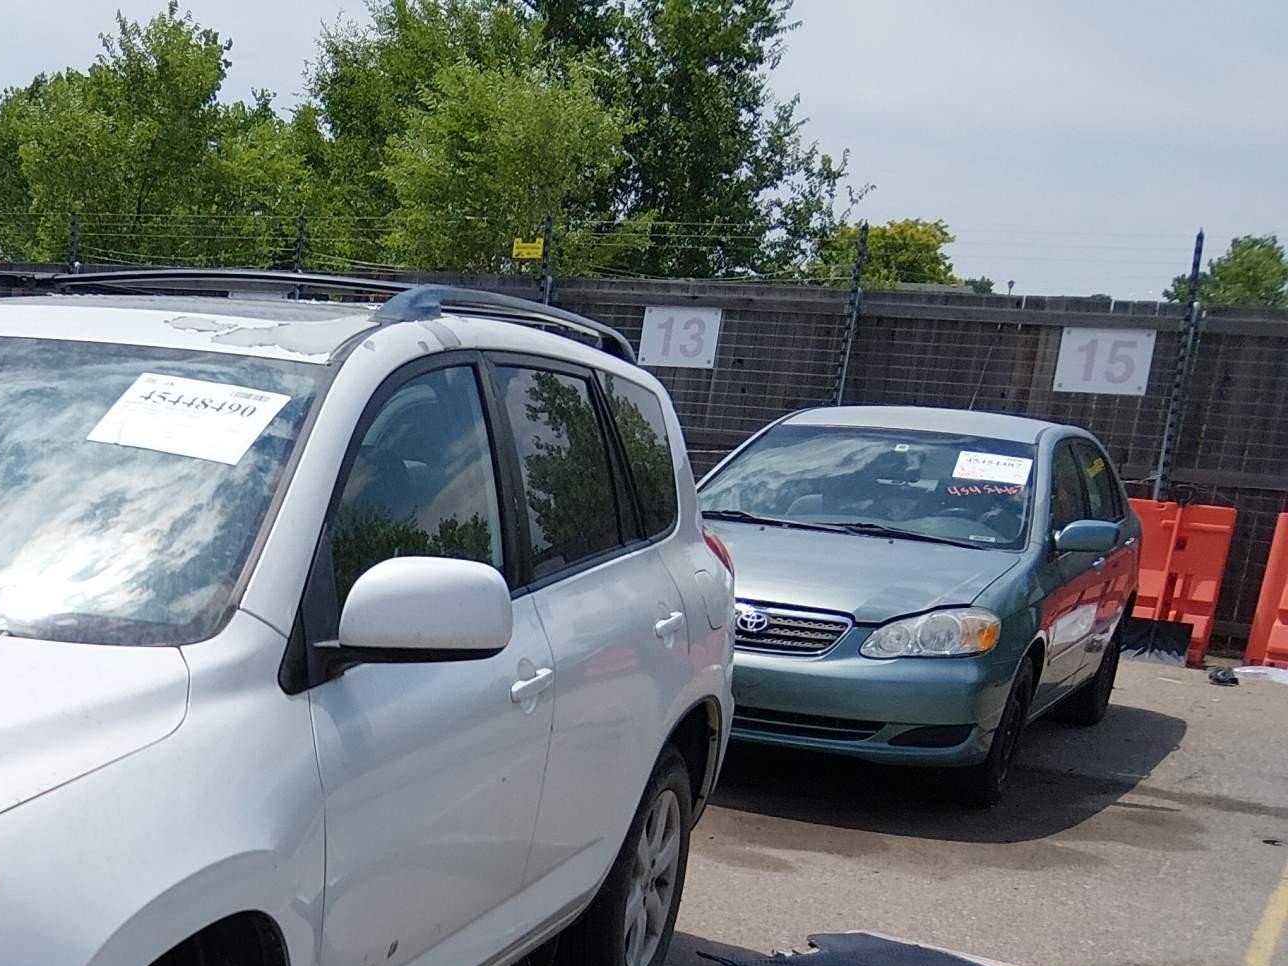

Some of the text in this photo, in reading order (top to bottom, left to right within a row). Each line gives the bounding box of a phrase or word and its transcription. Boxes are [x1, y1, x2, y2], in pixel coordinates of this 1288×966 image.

[656, 316, 707, 359] 13
[1075, 337, 1138, 385] 15
[139, 389, 258, 418] 45448490
